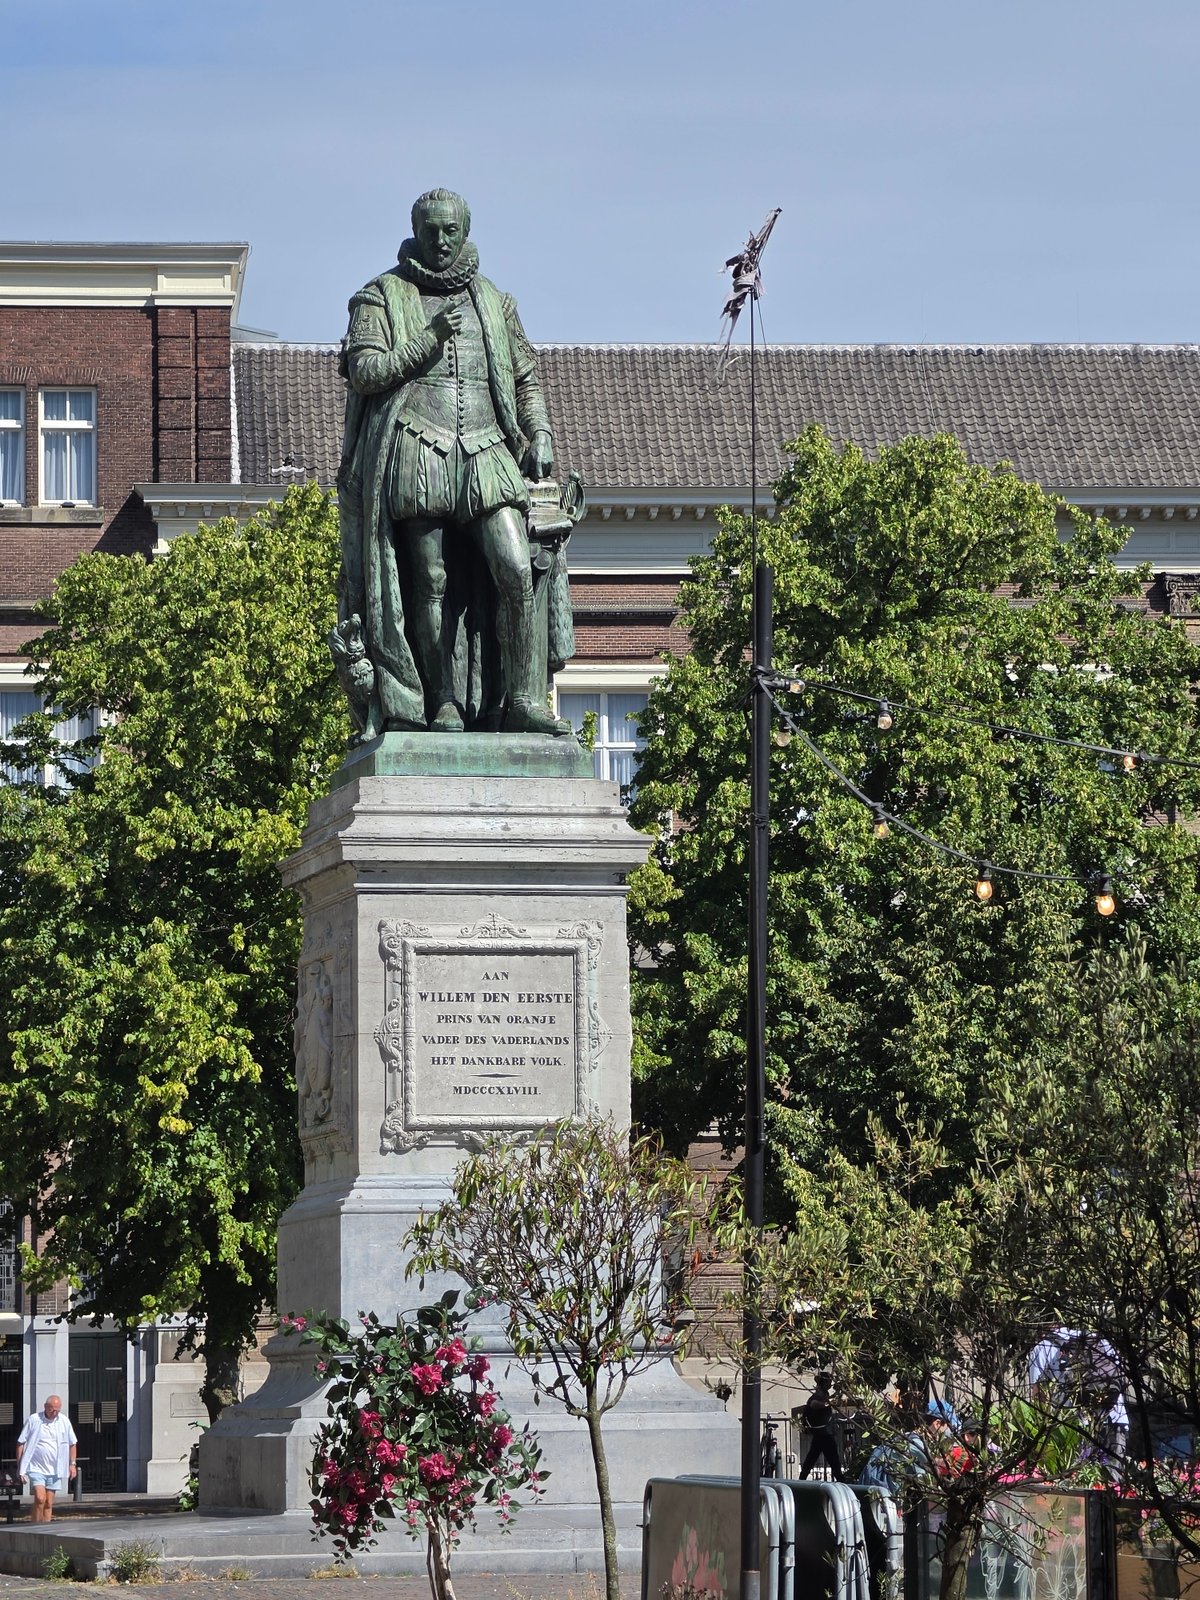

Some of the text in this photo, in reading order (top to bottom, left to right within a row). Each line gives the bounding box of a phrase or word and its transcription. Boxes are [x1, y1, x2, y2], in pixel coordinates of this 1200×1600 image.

[481, 971, 510, 981] AAN
[417, 991, 573, 1004] WILLEM DEN EERSTE
[436, 1014, 556, 1025] PRINS VAN ORANJE
[421, 1035, 570, 1046] VADER DES VADERLANDS
[431, 1056, 567, 1066] HET DANKBARE VOLK.
[453, 1085, 542, 1095] MDCCCXLVIII.
